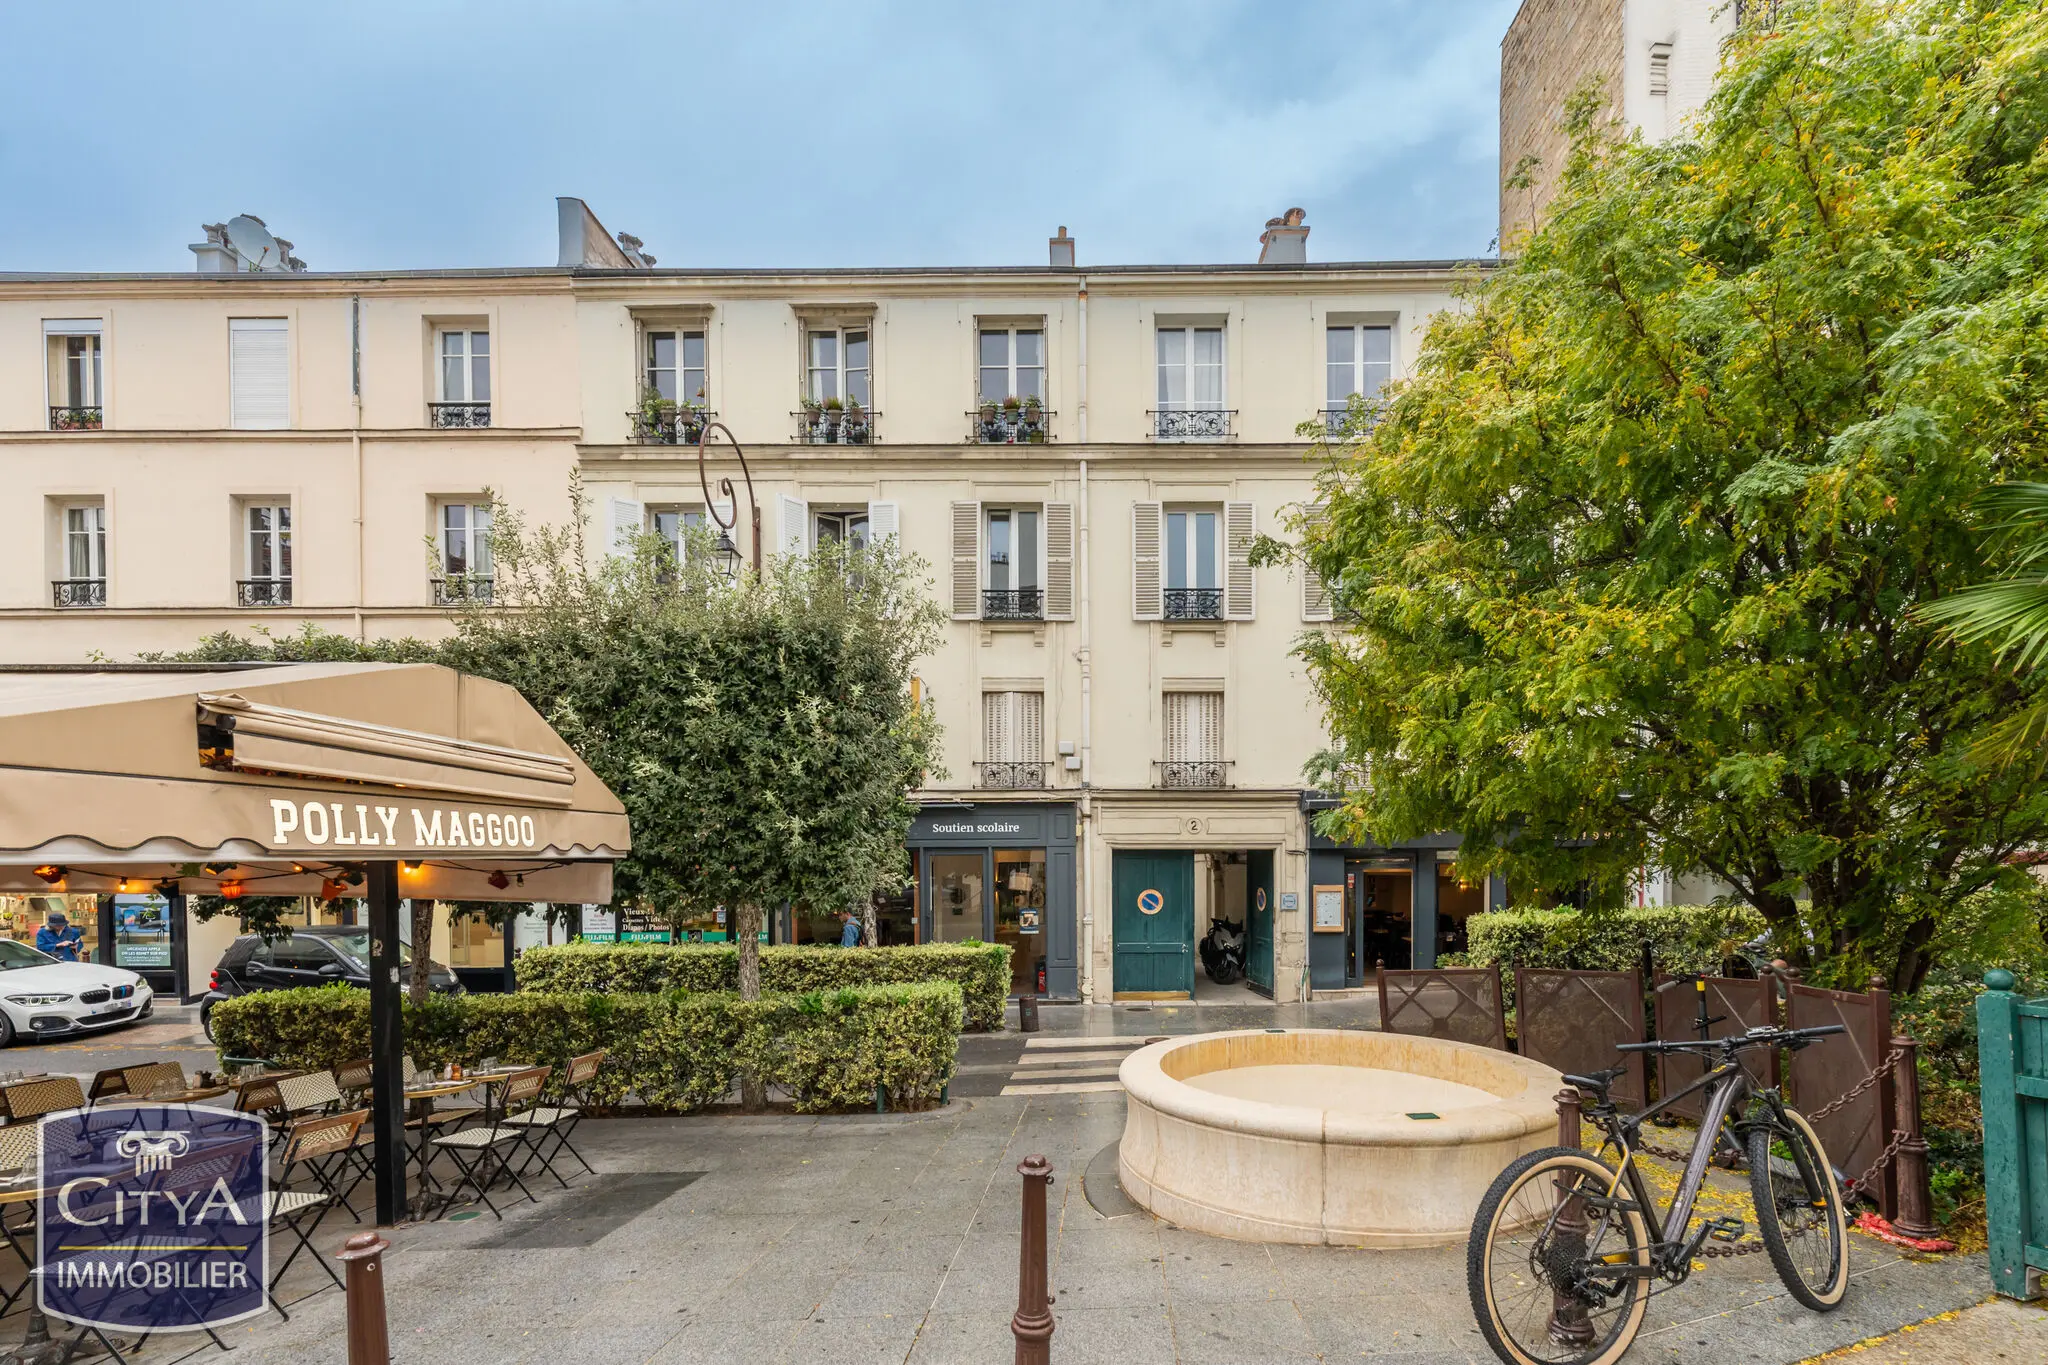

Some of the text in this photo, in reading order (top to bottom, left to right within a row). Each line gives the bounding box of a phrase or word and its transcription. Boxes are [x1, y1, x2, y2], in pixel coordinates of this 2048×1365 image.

[270, 799, 535, 847] POLLY MAGGOO
[932, 822, 1020, 833] Soutien scolaire
[1190, 820, 1198, 830] 2
